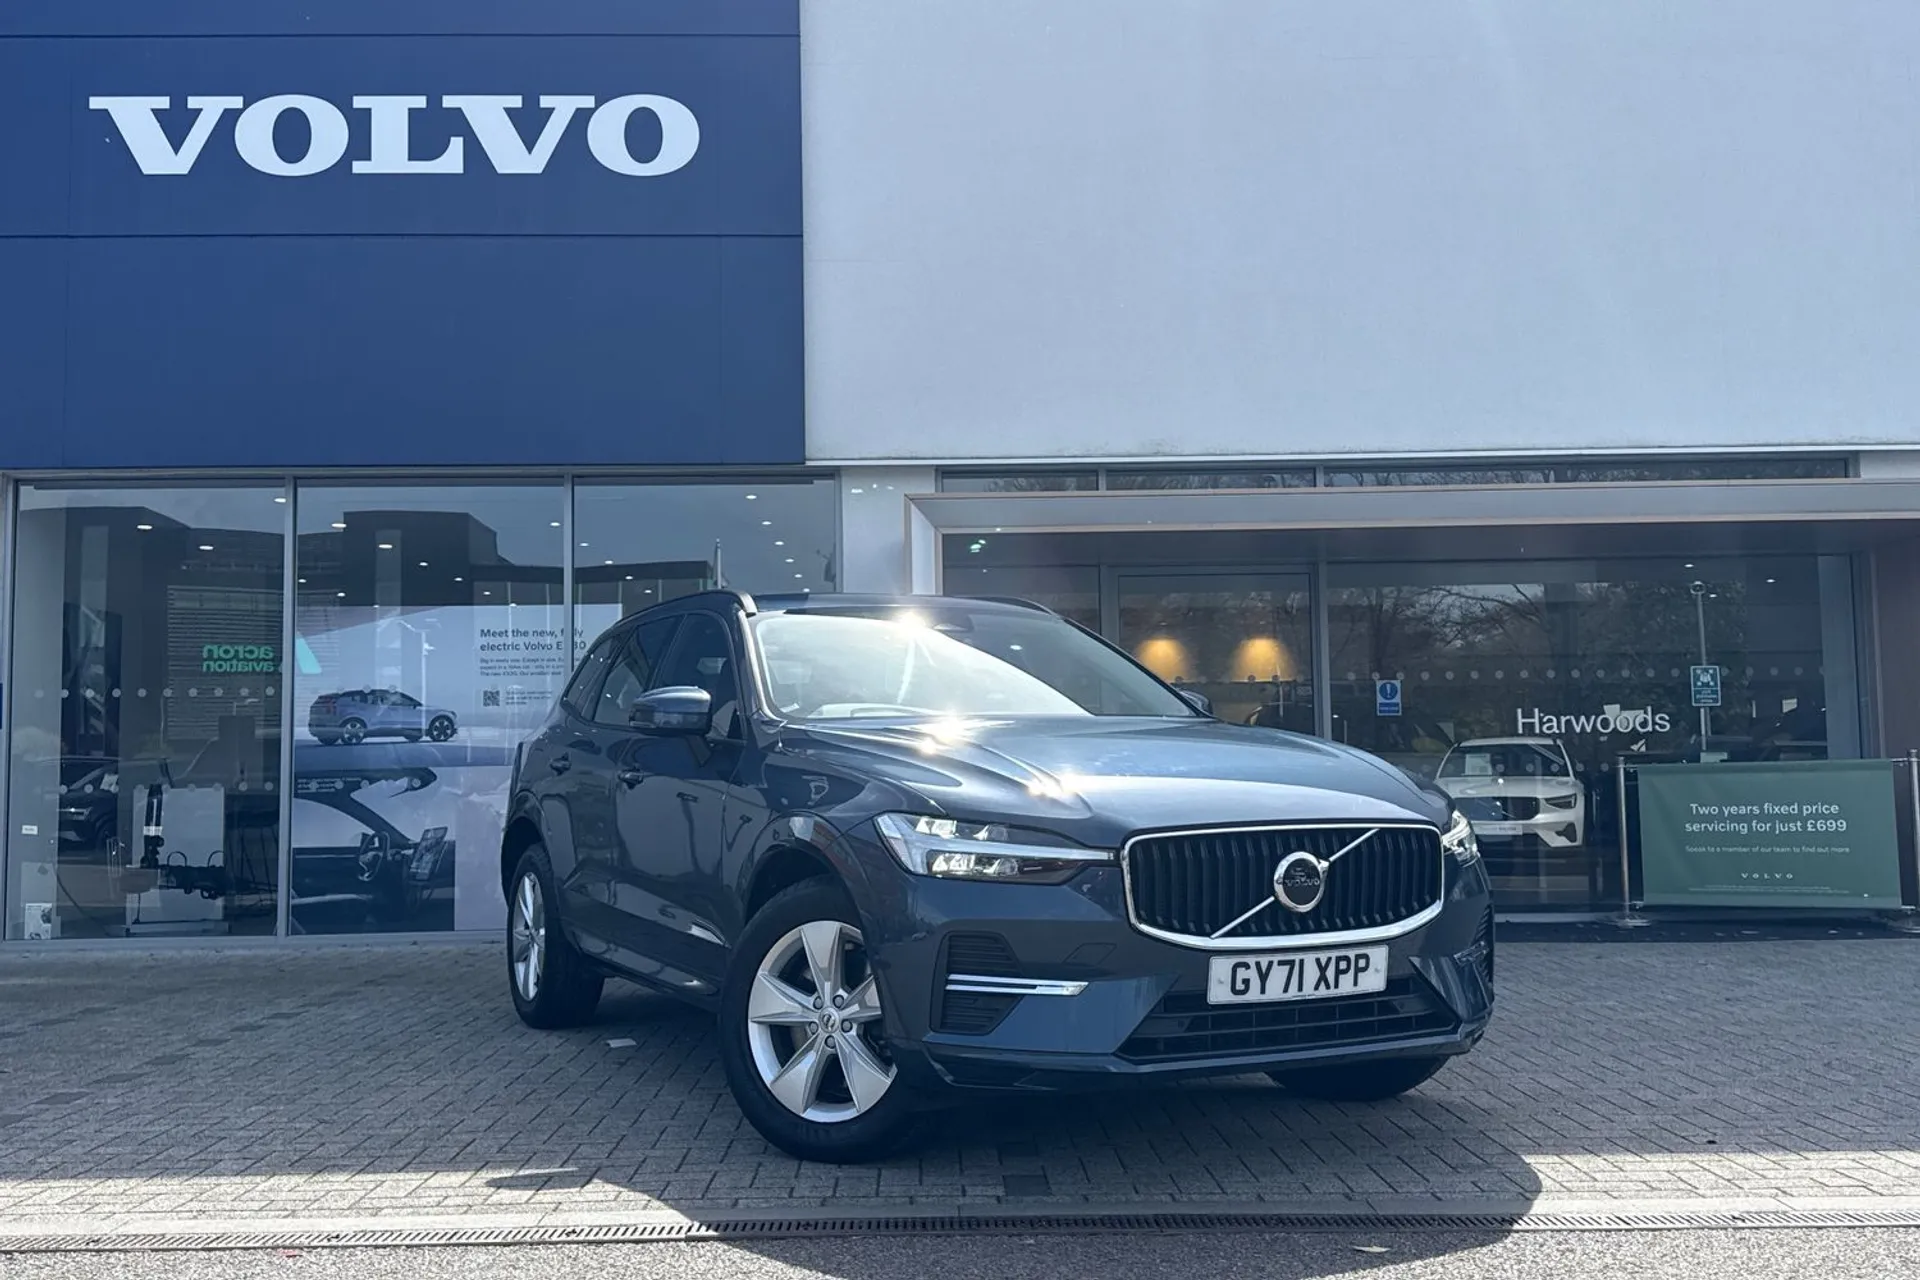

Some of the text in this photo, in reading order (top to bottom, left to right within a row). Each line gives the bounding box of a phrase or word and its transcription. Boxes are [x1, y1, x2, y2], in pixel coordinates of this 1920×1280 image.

[89, 94, 700, 176] VOLVO
[480, 628, 509, 638] Meet
[511, 628, 530, 638] the
[532, 630, 558, 639] new,
[480, 641, 587, 651] electric Volvo E30
[1516, 705, 1671, 734] Harwoods
[1689, 802, 1840, 818] Two years fixed price
[1685, 819, 1847, 835] servicing for just £699
[1230, 953, 1371, 996] GY71 XPP
